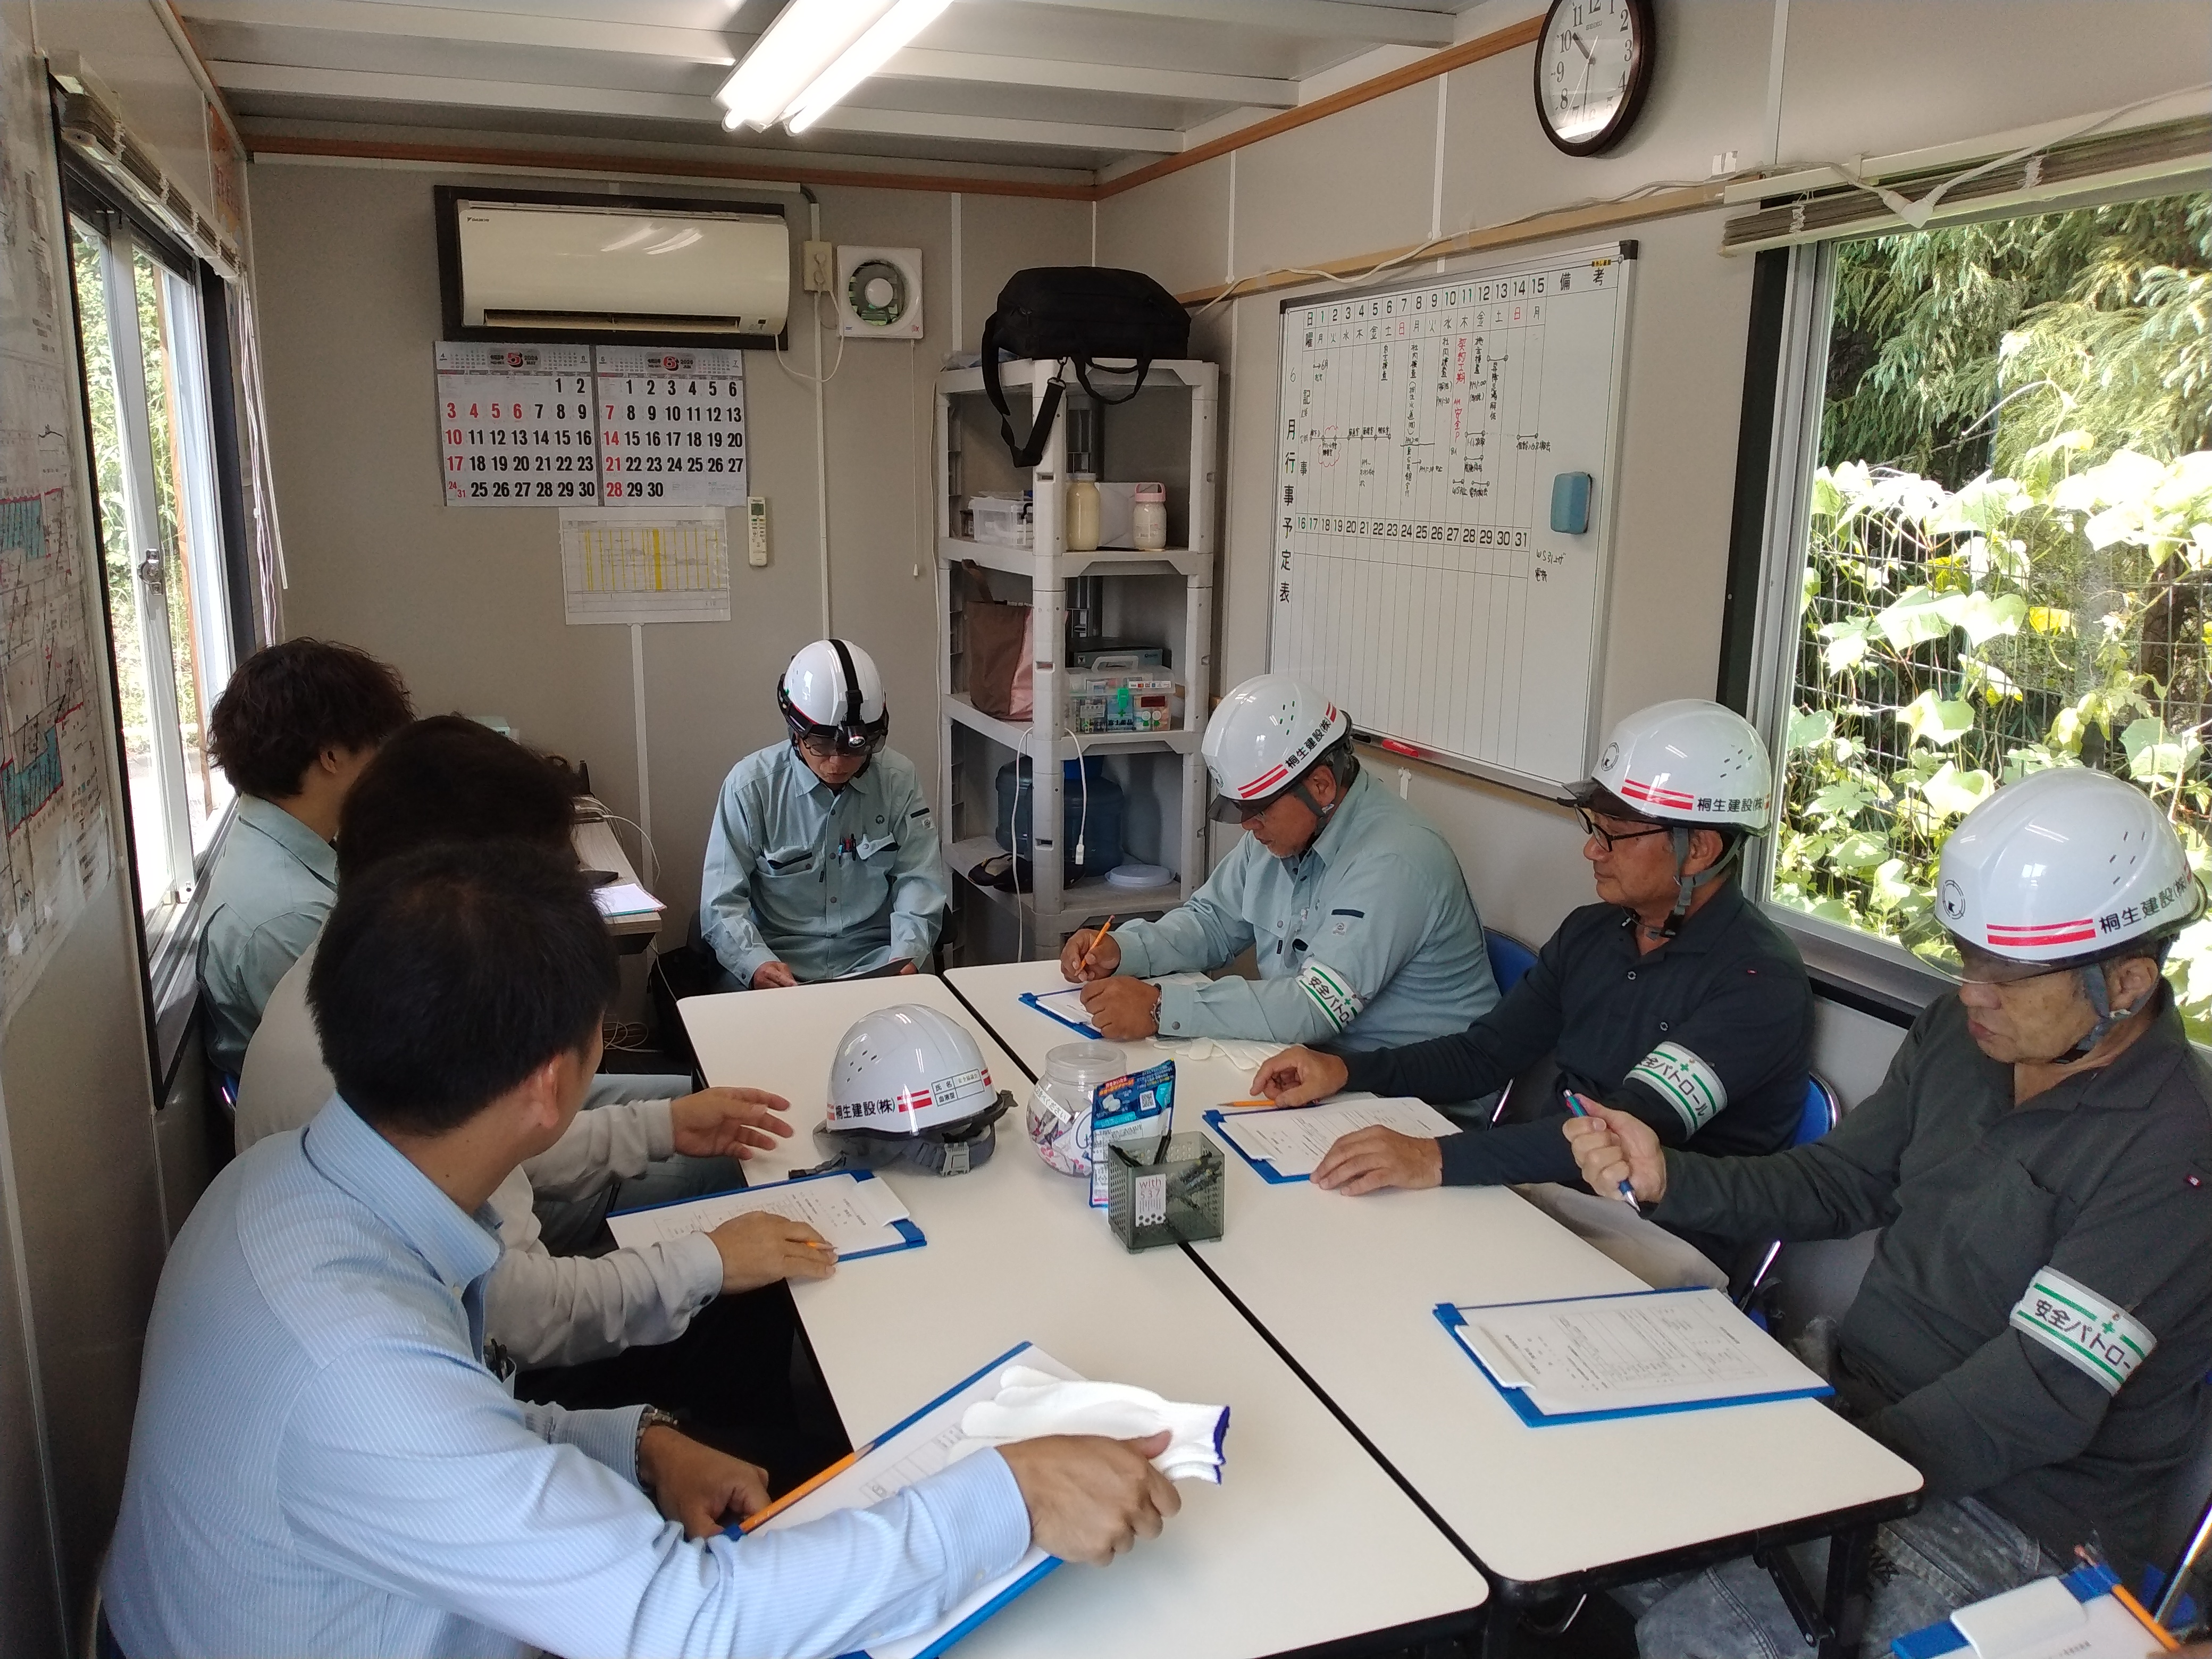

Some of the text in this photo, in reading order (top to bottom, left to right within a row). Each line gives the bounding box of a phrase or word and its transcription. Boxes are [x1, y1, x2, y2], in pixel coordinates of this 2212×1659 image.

[1572, 4, 1583, 27] 11
[1620, 9, 1629, 32] 2
[1586, 21, 1603, 30] SEIKO
[1560, 29, 1572, 53] 10
[1624, 39, 1632, 62] 3
[1556, 61, 1564, 82] 9
[1618, 70, 1627, 94] 4
[1560, 88, 1569, 110] 8
[1572, 105, 1580, 124] 7
[1307, 267, 1604, 326] 日 1 2 3 4 5 6 7 8 9 10 11 12 13 14 15 備考
[1305, 306, 1540, 348] 曜 月 火 水 木 金 土 日 月 火 水 木 金 土 日 月
[507, 351, 524, 368] 5
[663, 356, 679, 371] 6
[1291, 367, 1296, 382] 6
[555, 378, 585, 393] 1 2
[626, 379, 737, 397] 1 2 3 4 5 6
[447, 402, 586, 420] 3 4 5 6 7 8 9
[605, 405, 742, 423] 7 8 9 10 11 12 13
[445, 429, 592, 446] 10 11 12 13 14 15 16
[603, 431, 743, 448] 14 15 16 17 18 19 20
[447, 455, 594, 472] 17 18 19 20 21 22 23
[606, 456, 743, 473] 21 22 23 24 25 26 27
[448, 481, 595, 498] 24 31 25 26 27 28 29 30
[606, 482, 664, 497] 28 29 30
[1297, 517, 1527, 547] 16 17 18 19 20 21 22 23 24 25 26 27 28 29 30 31
[1309, 976, 1351, 1024] 安全パトロ
[1640, 1056, 1708, 1116] 全パトロール
[1139, 1176, 1161, 1189] with
